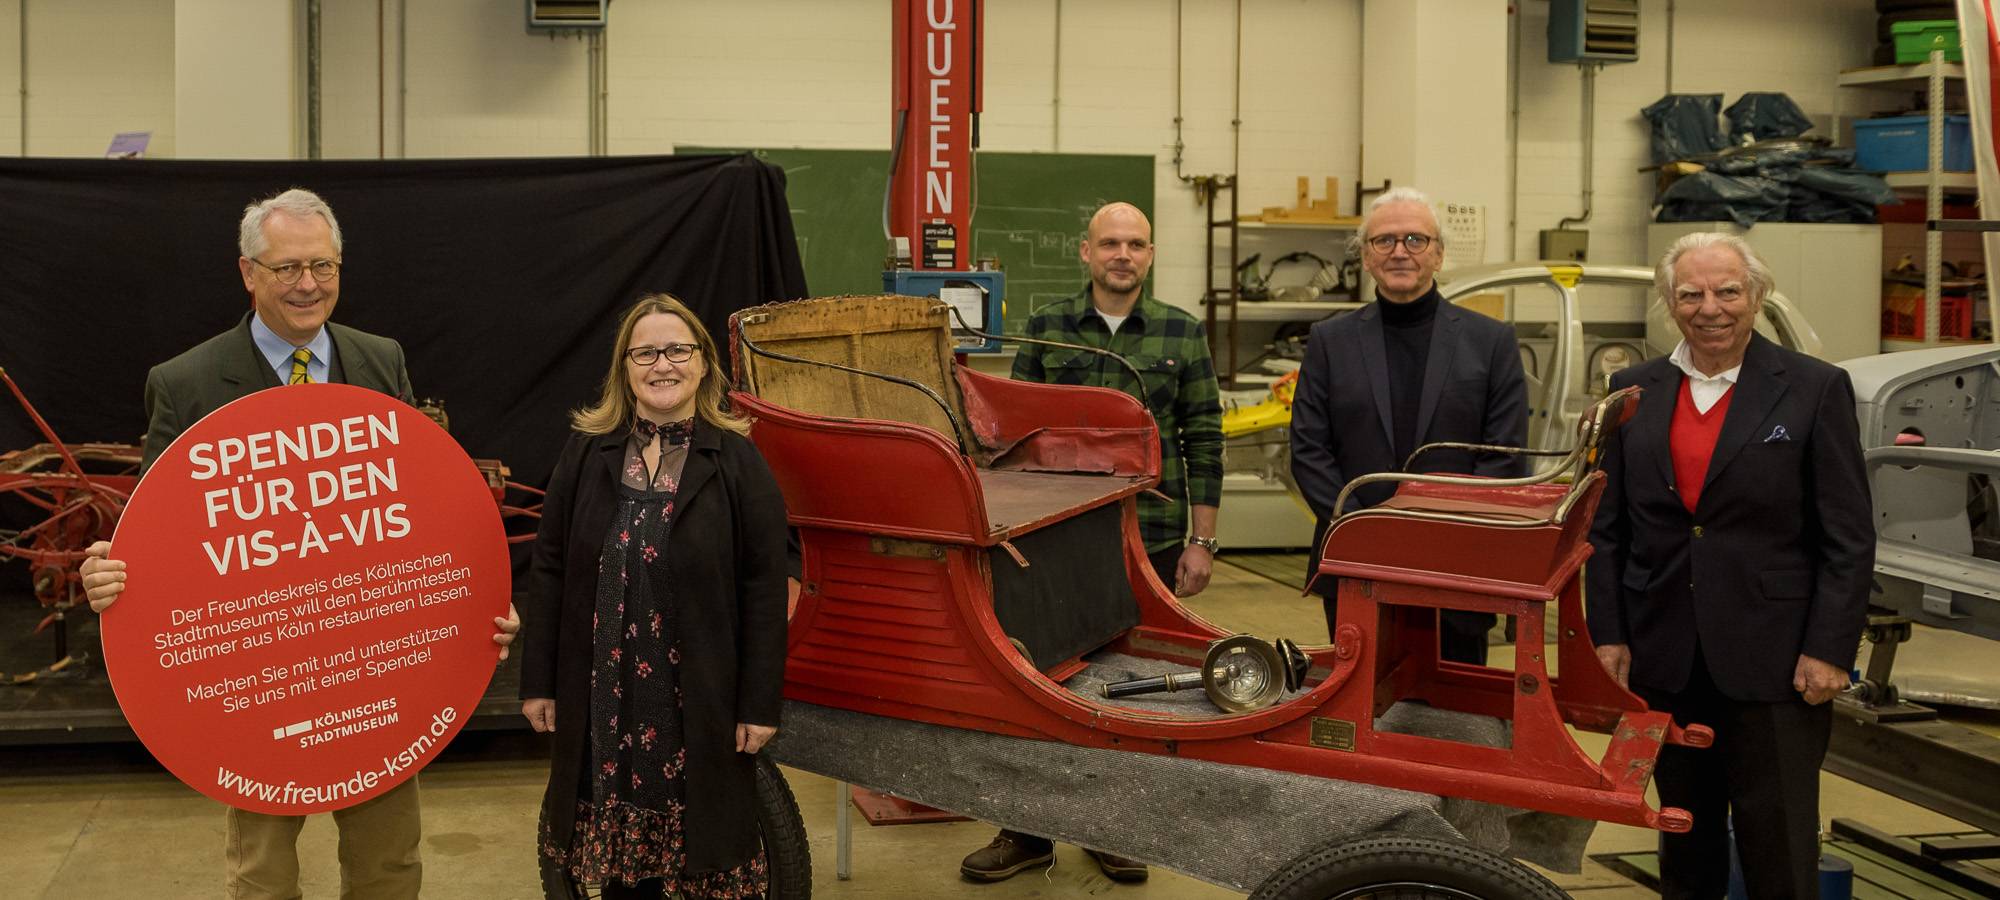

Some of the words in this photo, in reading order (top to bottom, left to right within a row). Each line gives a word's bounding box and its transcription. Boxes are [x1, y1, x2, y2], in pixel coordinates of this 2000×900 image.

[926, 0, 956, 214] QUEEN
[188, 410, 400, 480] SPENDEN
[204, 473, 299, 528] FÜR
[307, 457, 398, 508] DEN
[201, 503, 411, 576] VIS-À-VIS
[154, 608, 292, 650] Stadtmuseums
[291, 597, 322, 617] will
[324, 593, 356, 610] den
[360, 567, 471, 602] berühmtesten
[171, 608, 203, 626] Der
[208, 578, 328, 618] Freundeskreis
[332, 572, 362, 589] des
[366, 553, 452, 582] Kölnischen
[159, 640, 235, 668] Oldtimer
[242, 632, 273, 649] aus
[277, 620, 315, 641] Köln
[319, 598, 415, 631] restaurieren
[419, 586, 471, 607] lassen.
[186, 675, 257, 703] Machen
[261, 666, 288, 683] Sie
[292, 656, 320, 676] mit
[324, 646, 356, 668] und
[360, 625, 458, 659] unterstützen
[223, 695, 250, 713] Sie
[254, 687, 286, 705] uns
[290, 676, 318, 696] mit
[321, 667, 362, 688] einer
[365, 646, 431, 678] Spende!
[299, 712, 399, 748] STADTMUSEUM
[315, 697, 398, 729] KÖLNISCHES
[216, 705, 457, 805] www.freunde-ksm.de
